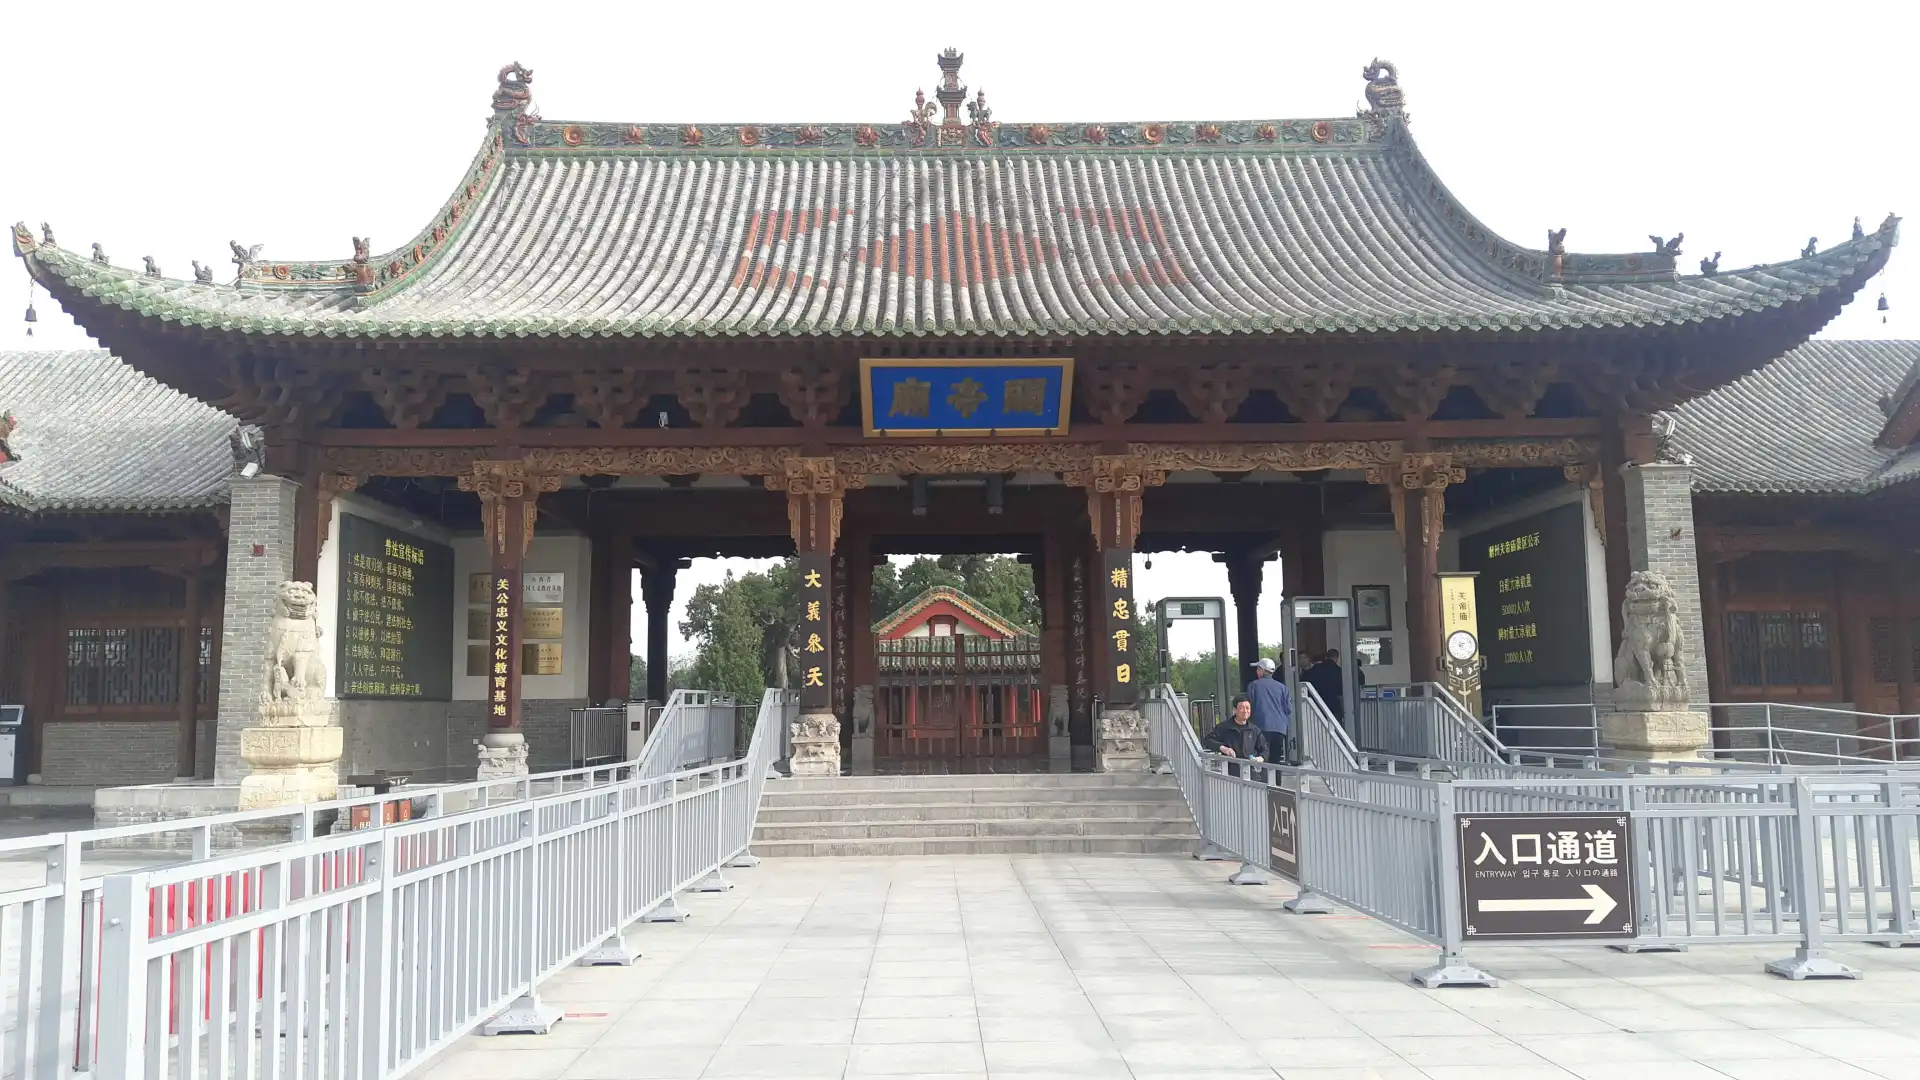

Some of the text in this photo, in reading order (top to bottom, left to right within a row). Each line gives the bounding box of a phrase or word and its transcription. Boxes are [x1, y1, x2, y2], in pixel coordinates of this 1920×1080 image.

[493, 578, 510, 717] 关公忠义文化教育基地
[1272, 800, 1290, 837] 入口
[1473, 830, 1619, 866] 入口通道
[1475, 870, 1517, 879] ENTRYWAY
[1522, 869, 1541, 879] 입구
